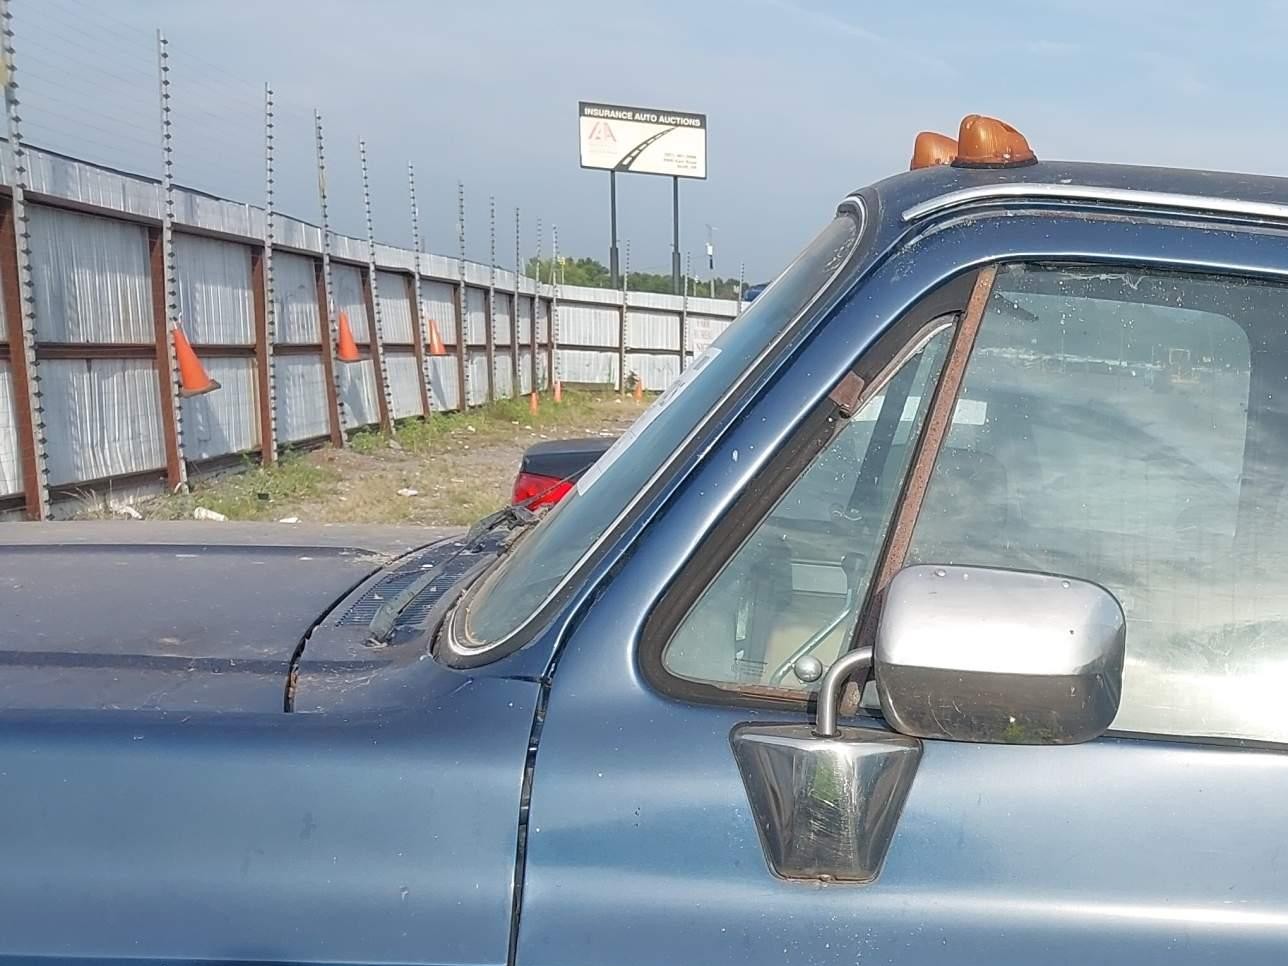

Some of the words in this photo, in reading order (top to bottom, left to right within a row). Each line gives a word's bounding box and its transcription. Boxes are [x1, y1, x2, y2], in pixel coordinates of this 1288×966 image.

[584, 106, 634, 120] INSURANCE
[634, 112, 658, 123] AUTO
[659, 115, 701, 128] AUCTIONS
